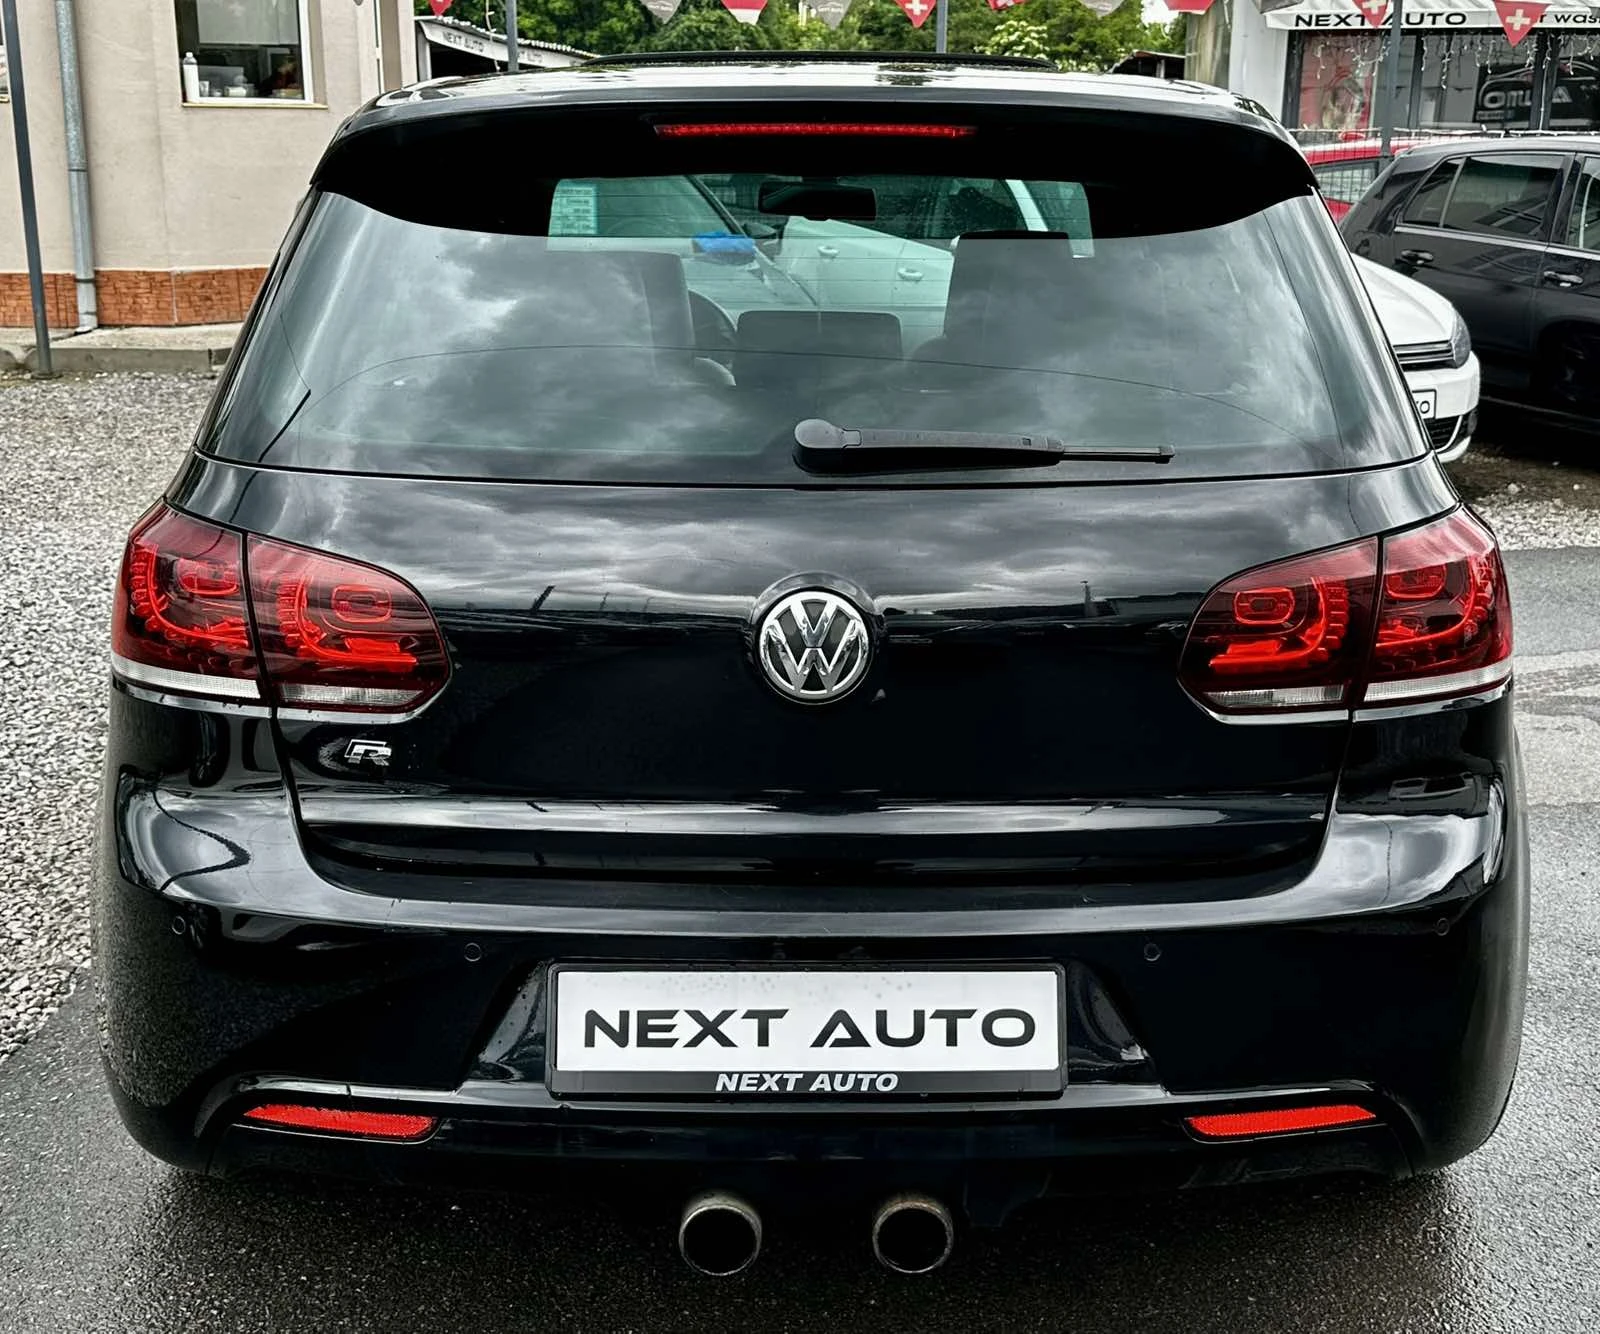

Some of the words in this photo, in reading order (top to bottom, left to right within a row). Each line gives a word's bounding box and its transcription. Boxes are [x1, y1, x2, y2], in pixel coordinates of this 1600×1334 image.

[1294, 13, 1366, 27] NEXT
[1554, 14, 1600, 24] was
[584, 1008, 790, 1048] NEXT
[809, 1008, 1036, 1048] AUTO
[715, 1073, 804, 1092] NEXT
[808, 1073, 899, 1092] AUTO
